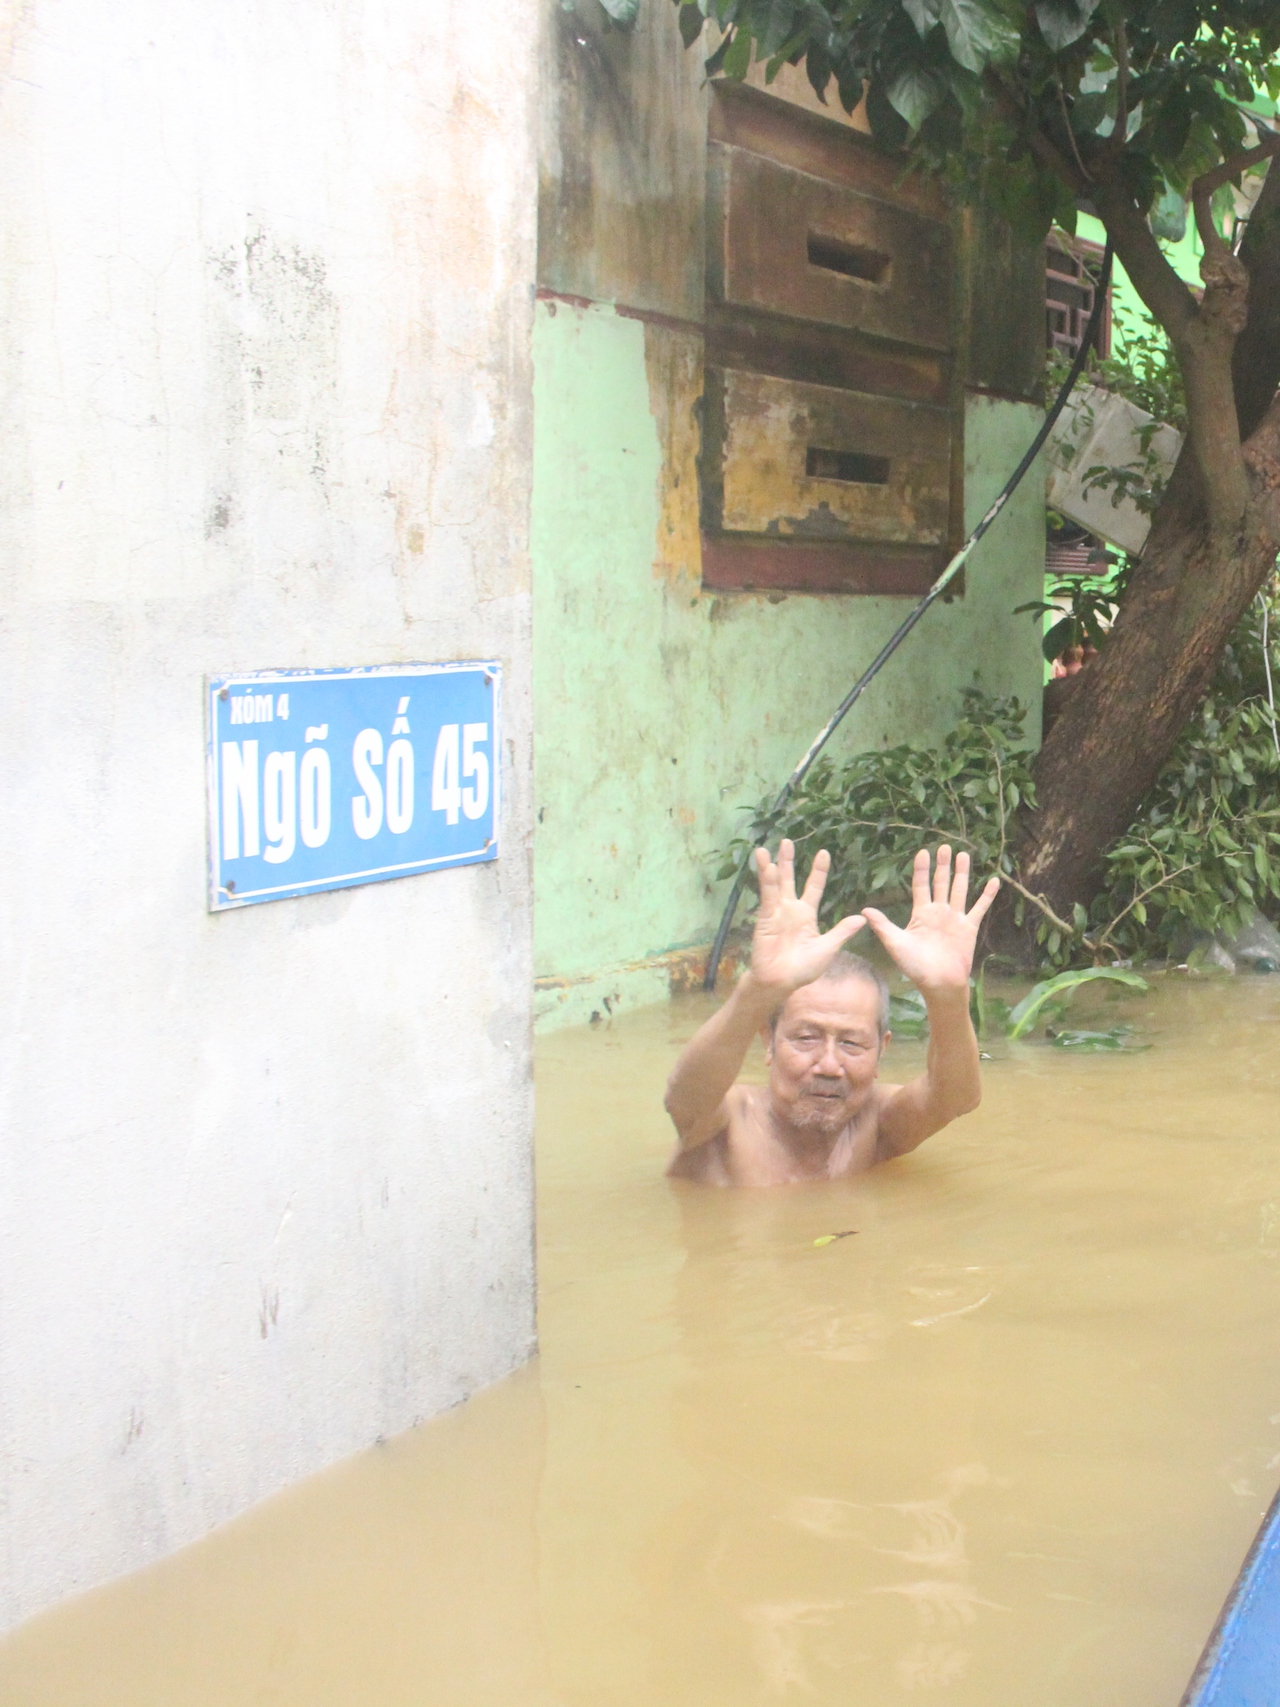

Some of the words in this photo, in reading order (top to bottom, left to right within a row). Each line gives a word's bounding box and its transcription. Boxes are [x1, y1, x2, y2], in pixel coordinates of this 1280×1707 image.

[276, 693, 290, 721] 4
[221, 723, 332, 864] Ngõ
[352, 696, 415, 840] Số
[431, 722, 489, 826] 45
